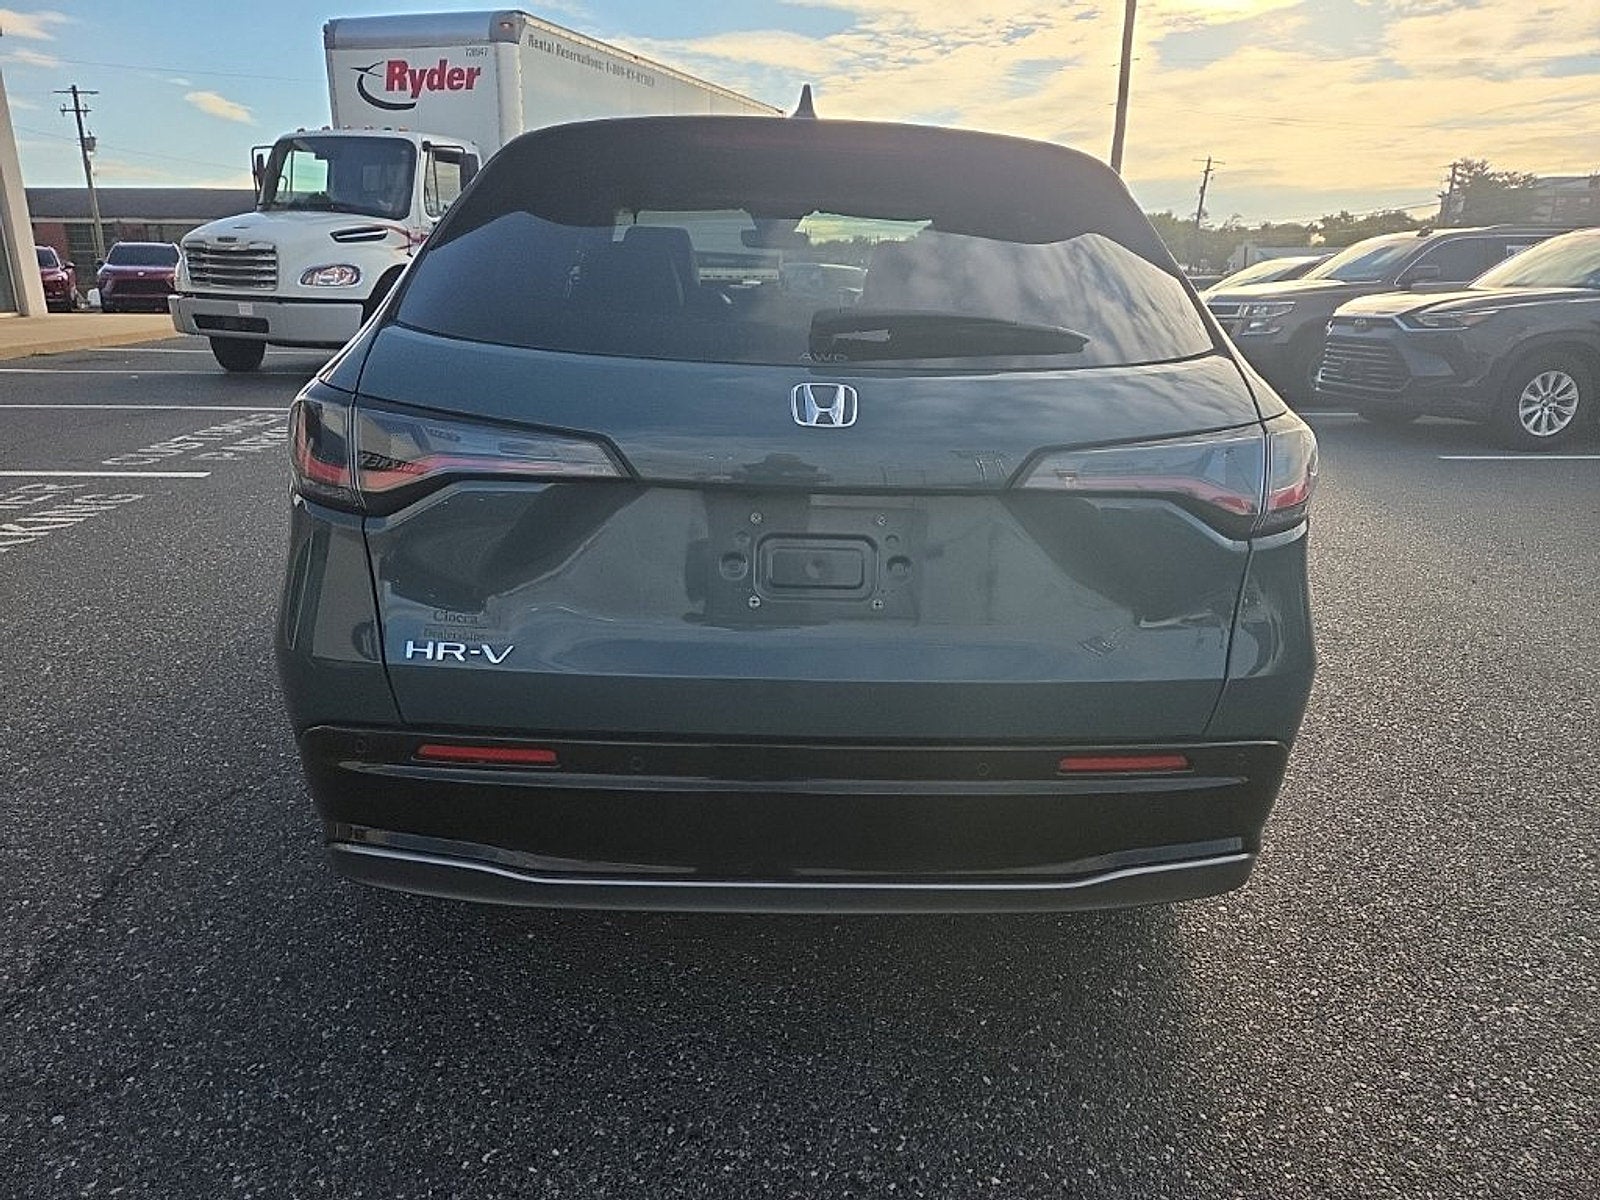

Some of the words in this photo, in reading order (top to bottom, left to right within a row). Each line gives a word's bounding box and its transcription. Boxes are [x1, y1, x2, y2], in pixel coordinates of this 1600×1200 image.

[528, 34, 554, 54] Rental
[386, 58, 481, 99] Ryder
[405, 640, 515, 665] HR-V
